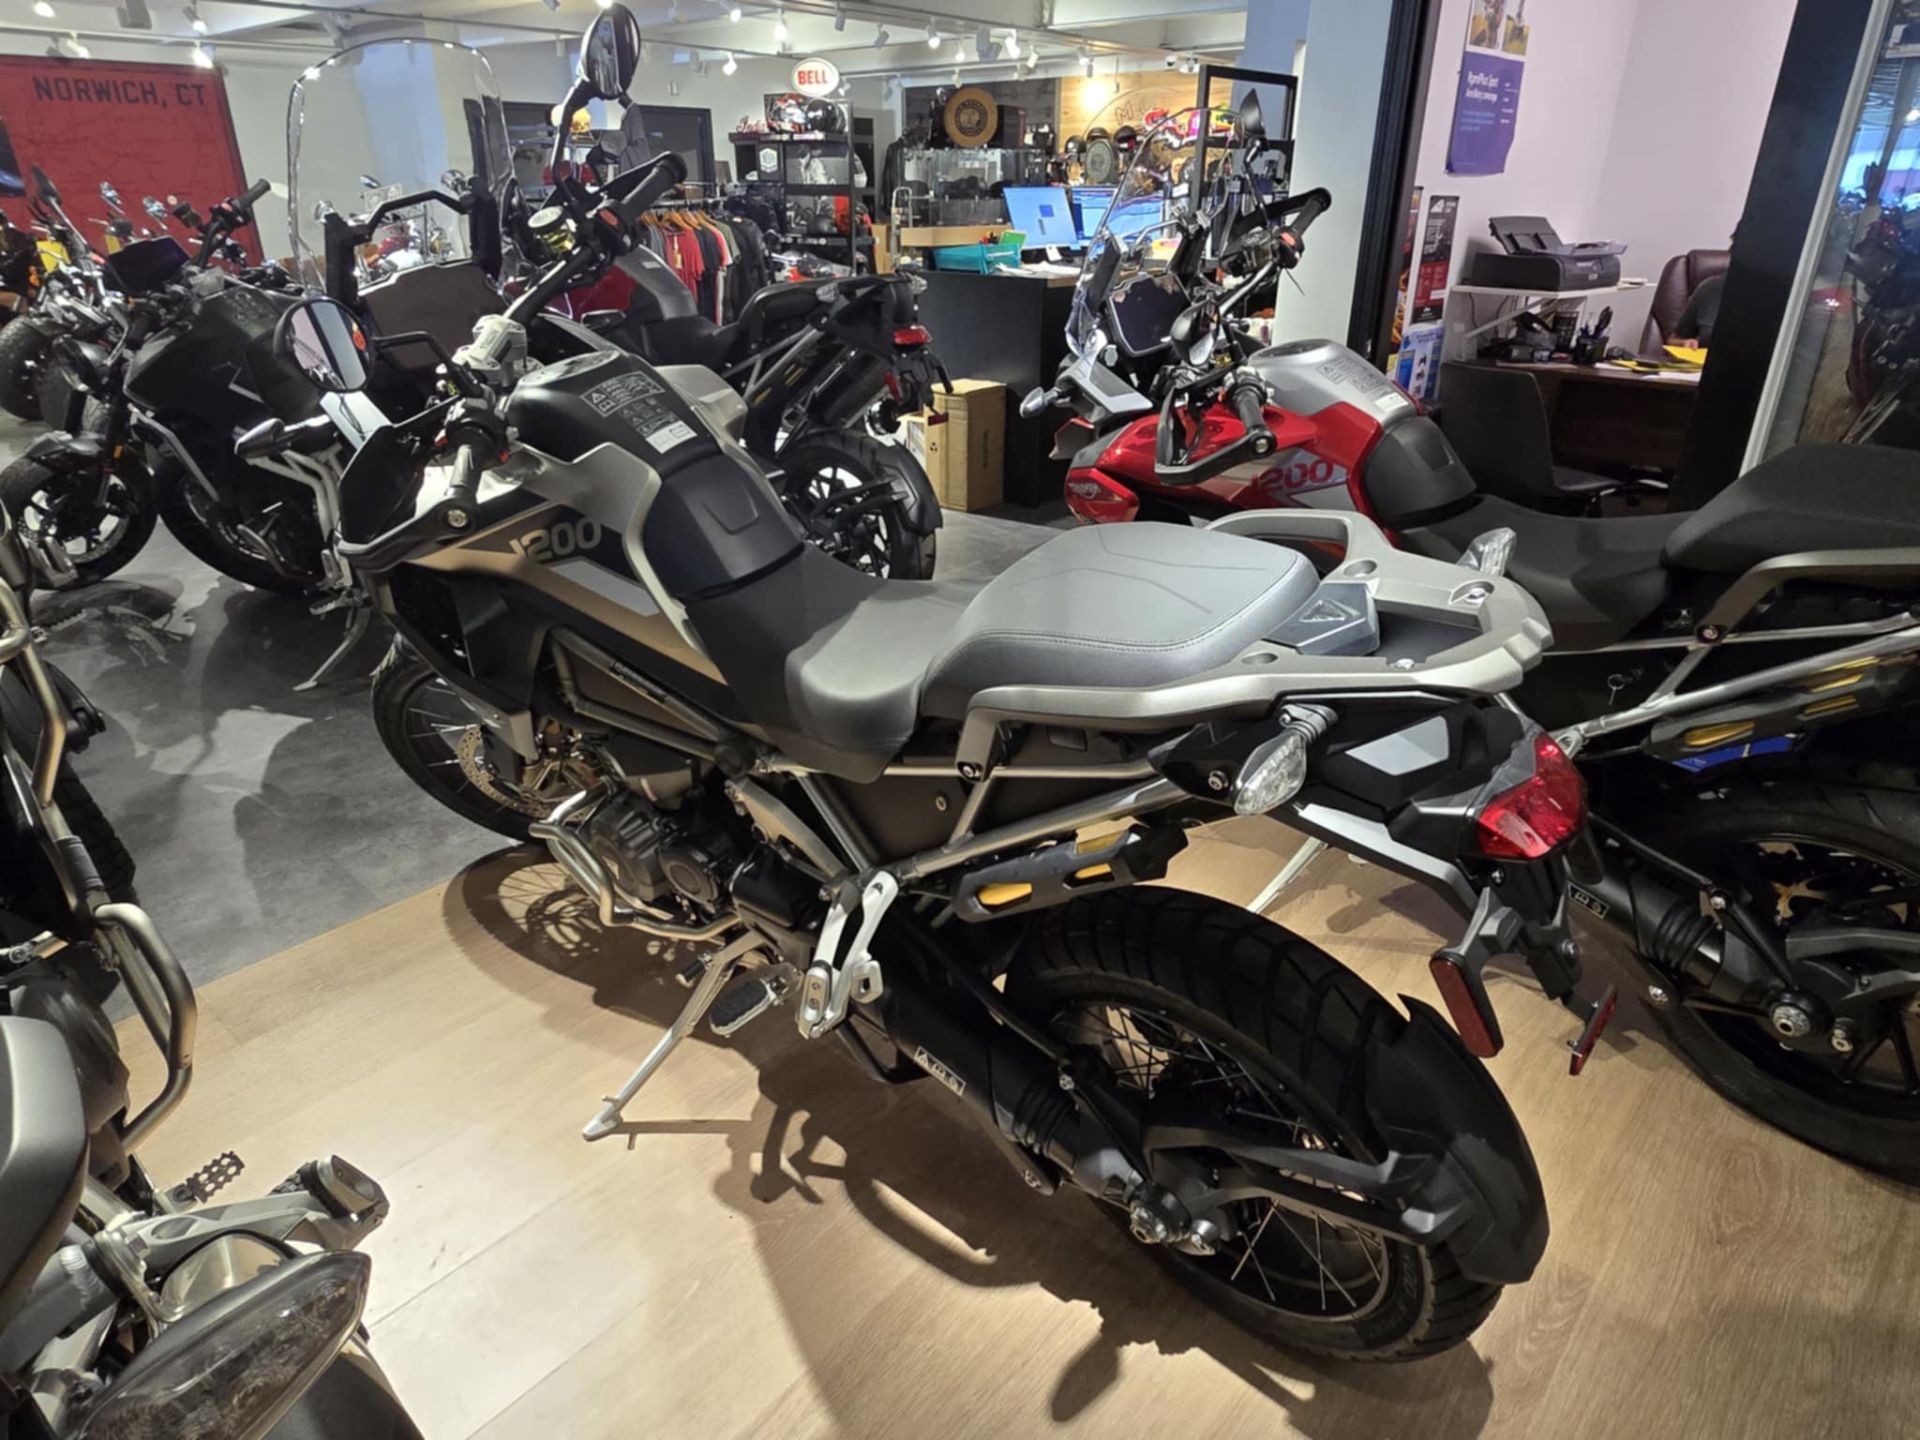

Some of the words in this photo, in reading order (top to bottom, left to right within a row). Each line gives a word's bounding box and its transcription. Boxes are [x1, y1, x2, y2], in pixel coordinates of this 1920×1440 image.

[797, 70, 828, 85] BELL
[32, 77, 167, 108] NORWICH,
[175, 83, 205, 106] CT
